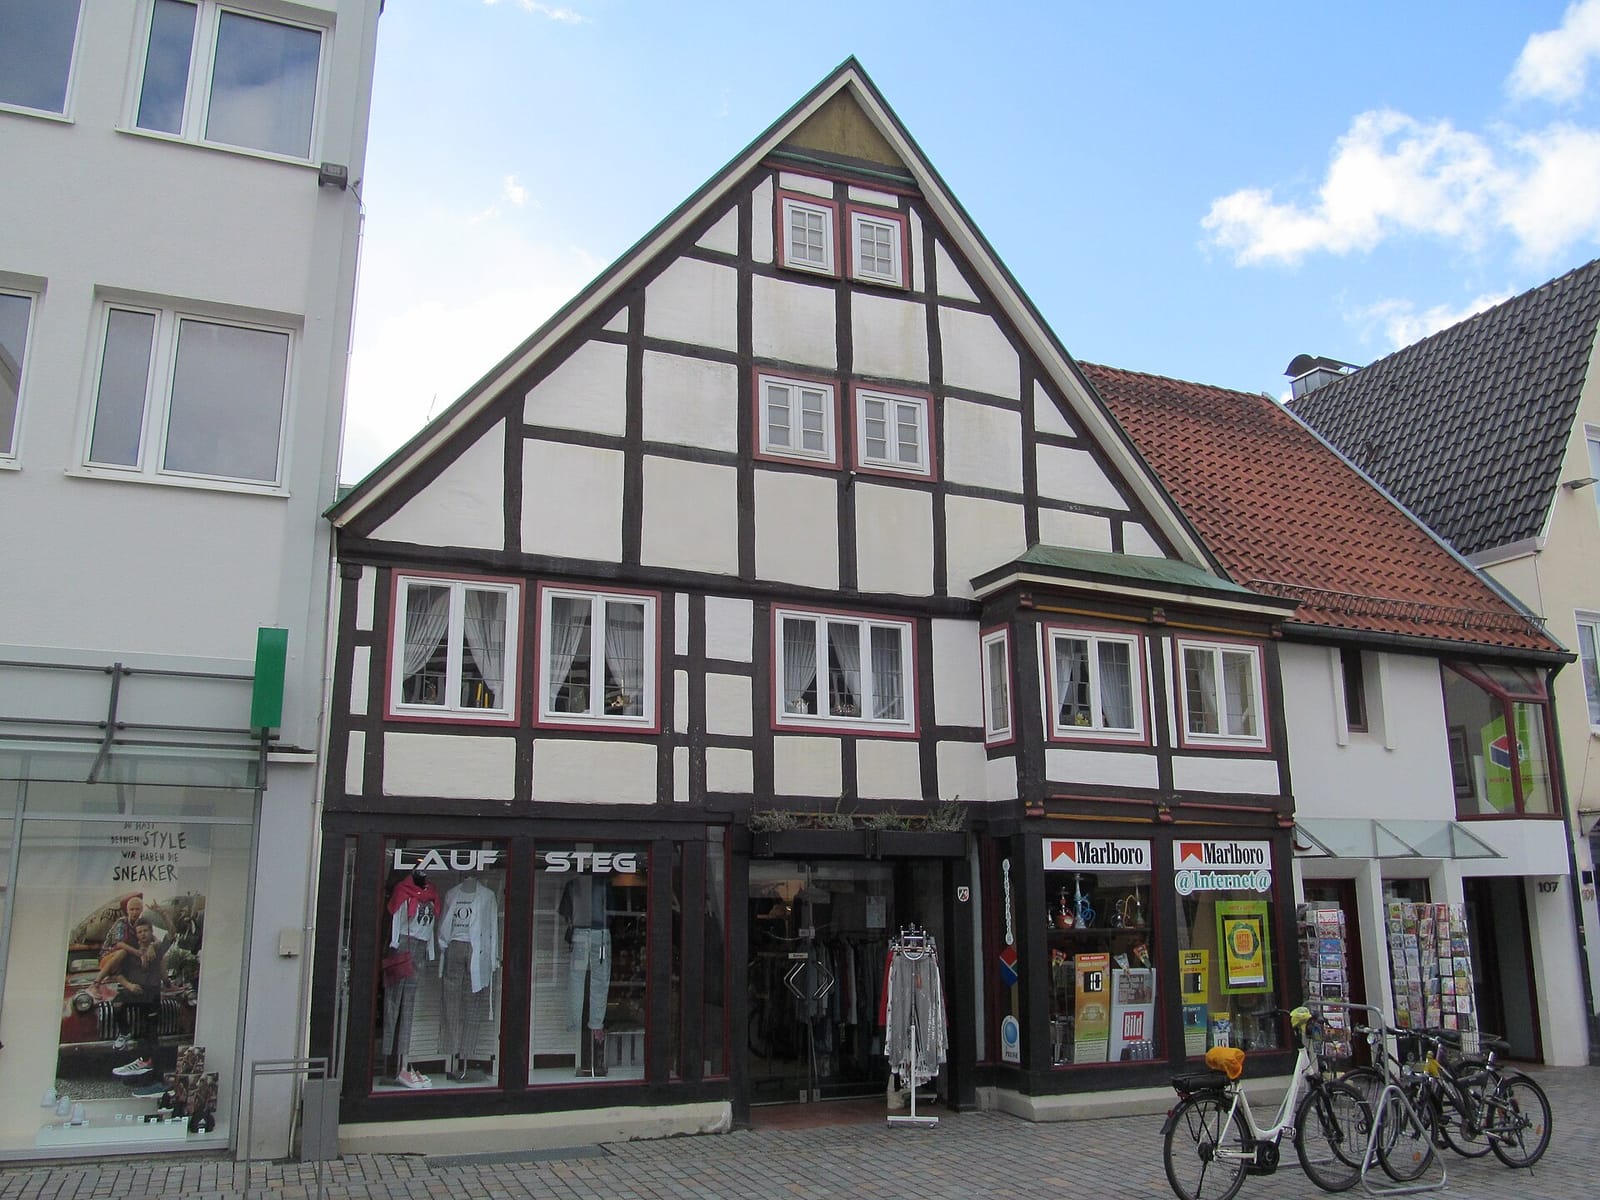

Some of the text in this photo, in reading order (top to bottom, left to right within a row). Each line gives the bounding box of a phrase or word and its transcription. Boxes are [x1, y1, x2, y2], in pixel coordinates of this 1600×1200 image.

[142, 830, 187, 850] STYLE
[121, 850, 179, 863] WIR HABEN DIE
[393, 848, 500, 871] LAUF
[544, 851, 637, 873] STEG
[1077, 841, 1143, 864] Marlboro
[1203, 843, 1264, 865] Marlboro
[112, 864, 178, 882] SNEAKER
[1176, 870, 1271, 894] @Internet@
[1537, 881, 1559, 893] 107
[1090, 972, 1102, 991] 10
[1123, 1014, 1143, 1038] Bild
